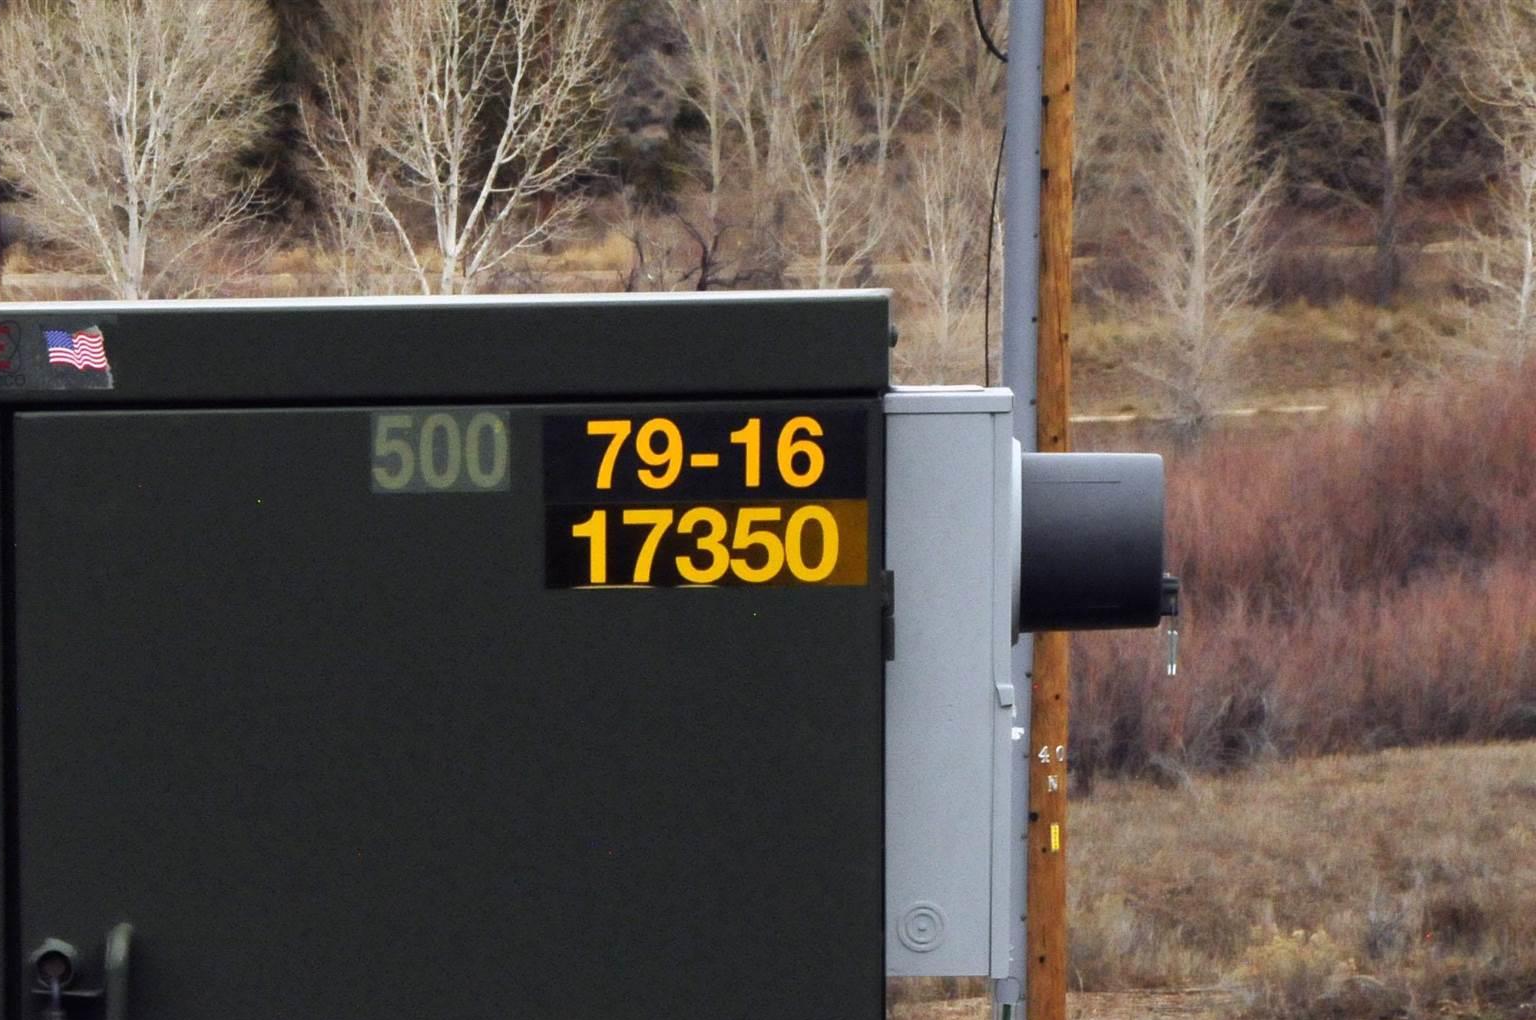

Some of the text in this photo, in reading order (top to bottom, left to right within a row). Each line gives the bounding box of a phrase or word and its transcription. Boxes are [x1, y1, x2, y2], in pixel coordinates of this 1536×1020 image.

[371, 412, 508, 490] 500
[586, 416, 825, 490] 79-16
[571, 505, 839, 585] 17350
